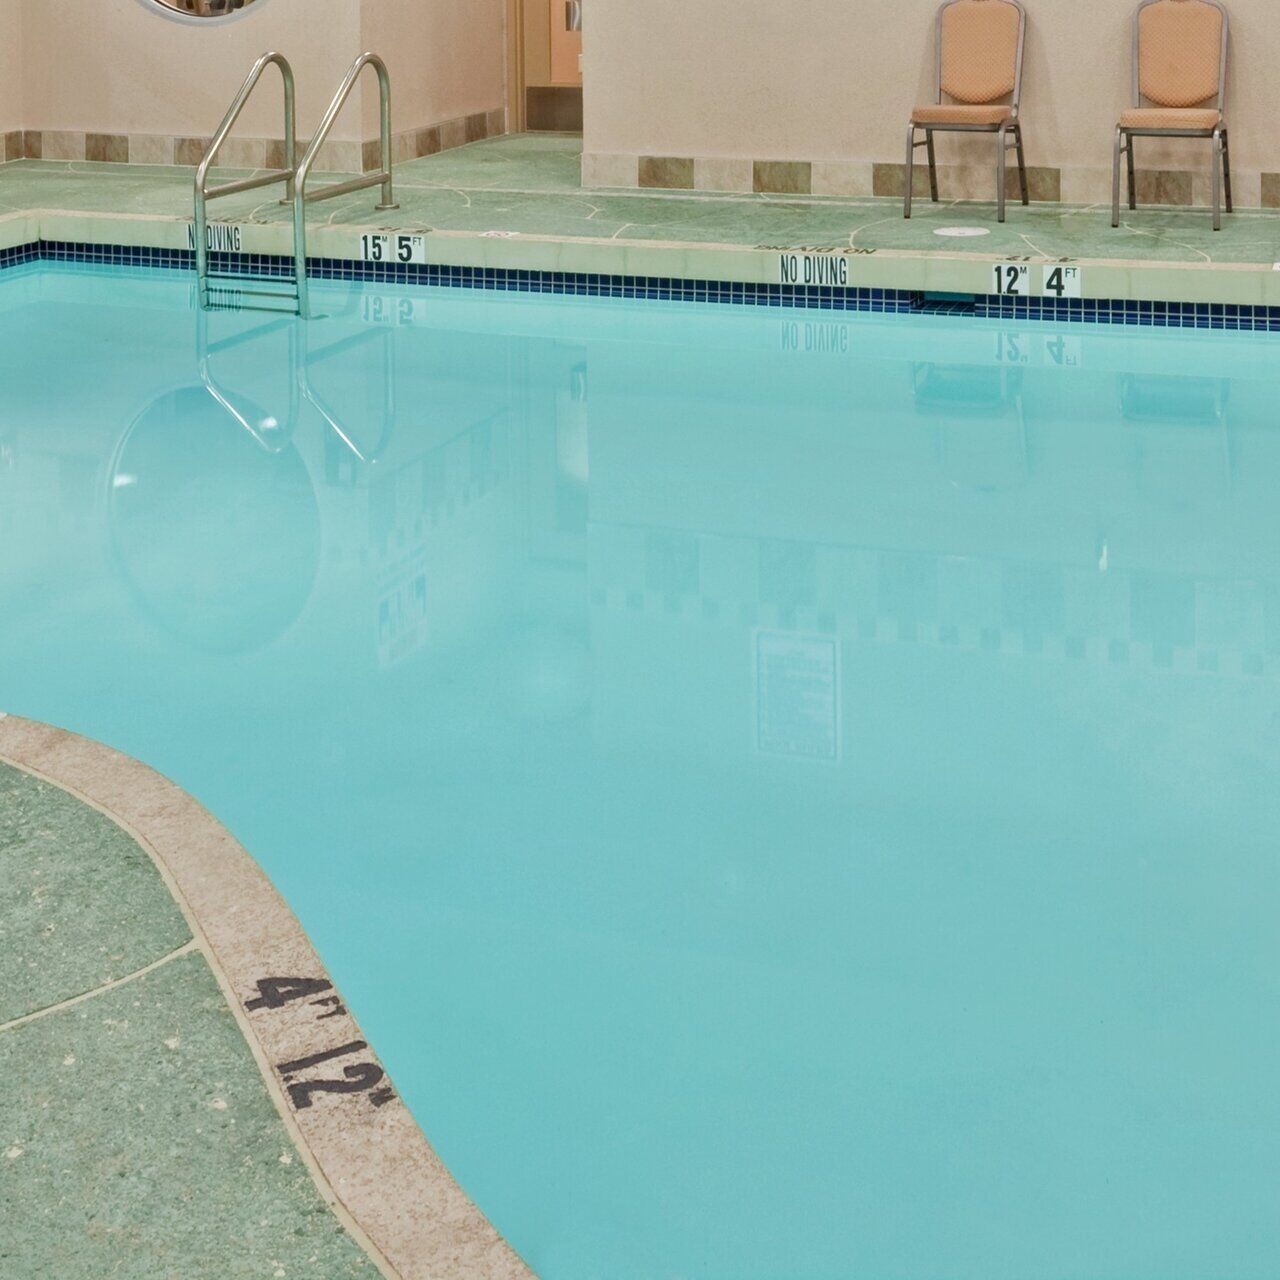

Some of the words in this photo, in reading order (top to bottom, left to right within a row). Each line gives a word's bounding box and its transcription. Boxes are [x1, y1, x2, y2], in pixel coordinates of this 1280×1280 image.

[207, 224, 240, 251] DIVING
[780, 254, 798, 283] NO
[804, 255, 847, 285] DIVING
